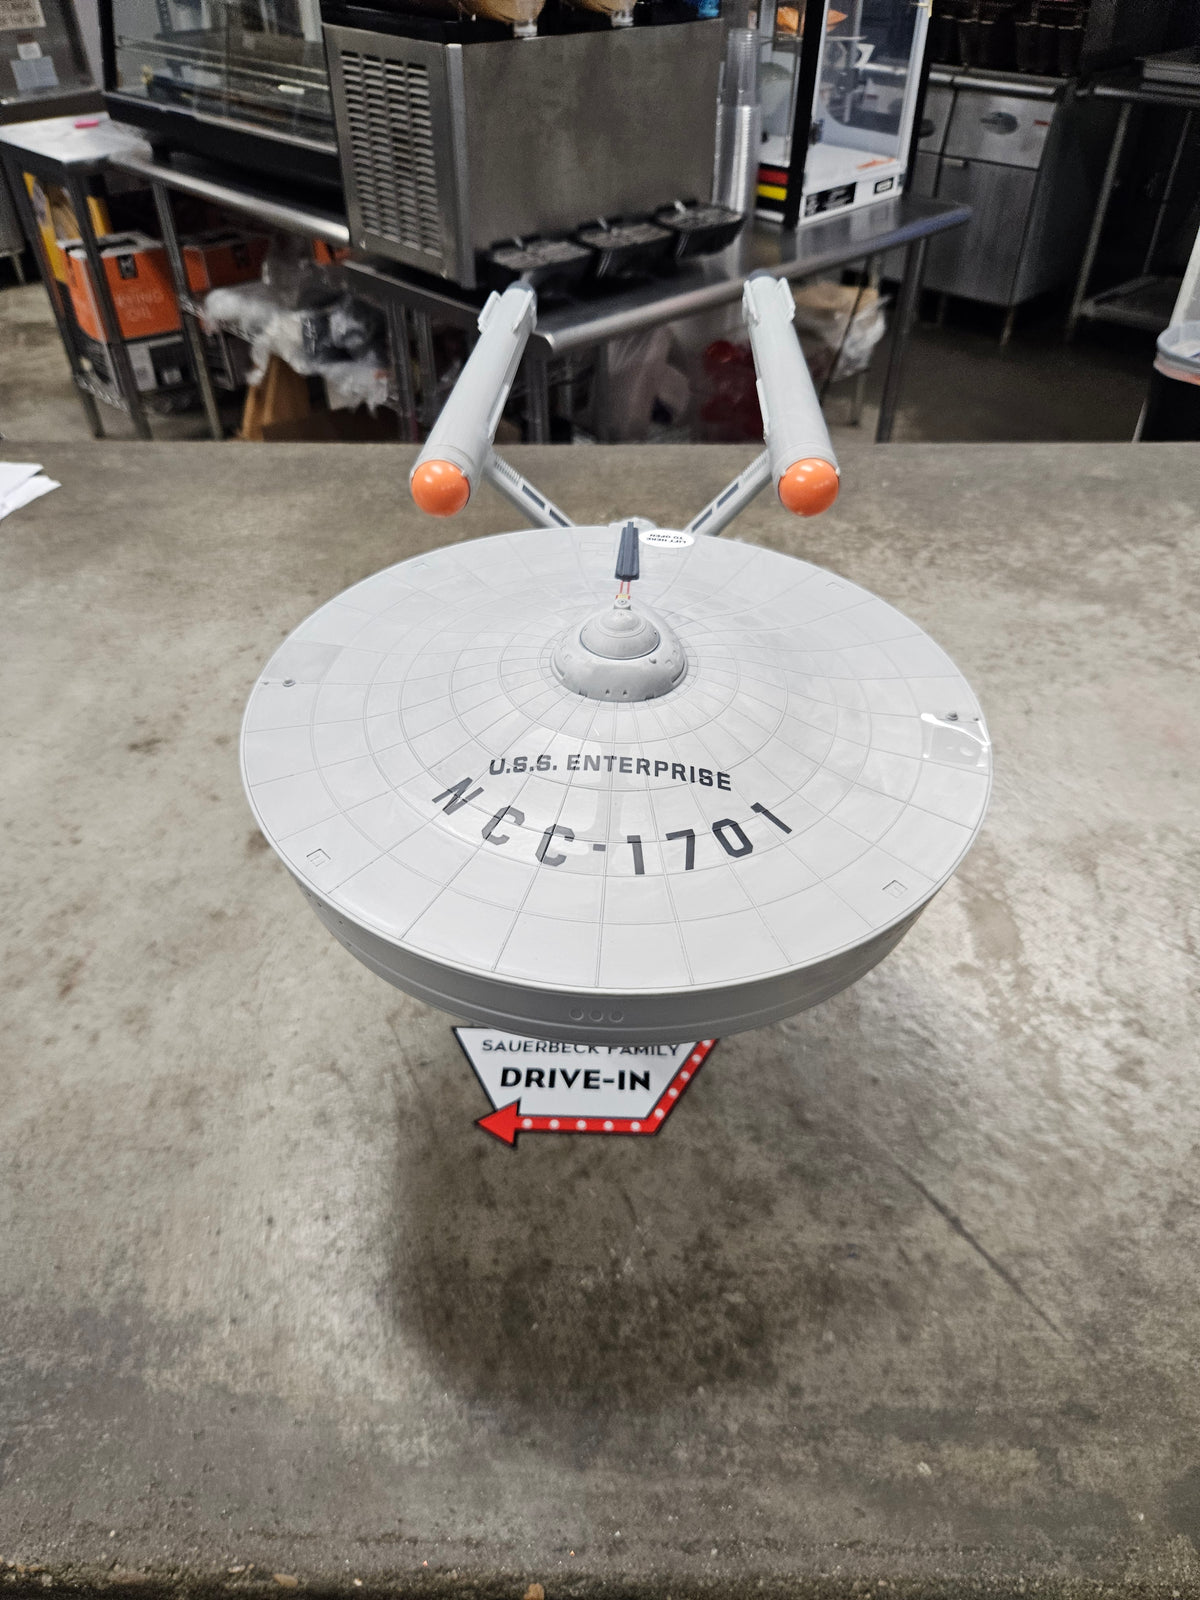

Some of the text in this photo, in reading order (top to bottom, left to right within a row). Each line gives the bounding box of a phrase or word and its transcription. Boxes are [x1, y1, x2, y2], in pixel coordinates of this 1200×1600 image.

[489, 754, 732, 791] U.S.S. ENTERPRISE
[431, 777, 793, 875] NCC-1701
[482, 1039, 599, 1054] SAUERBECK
[500, 1066, 651, 1091] DRIVE-IN
